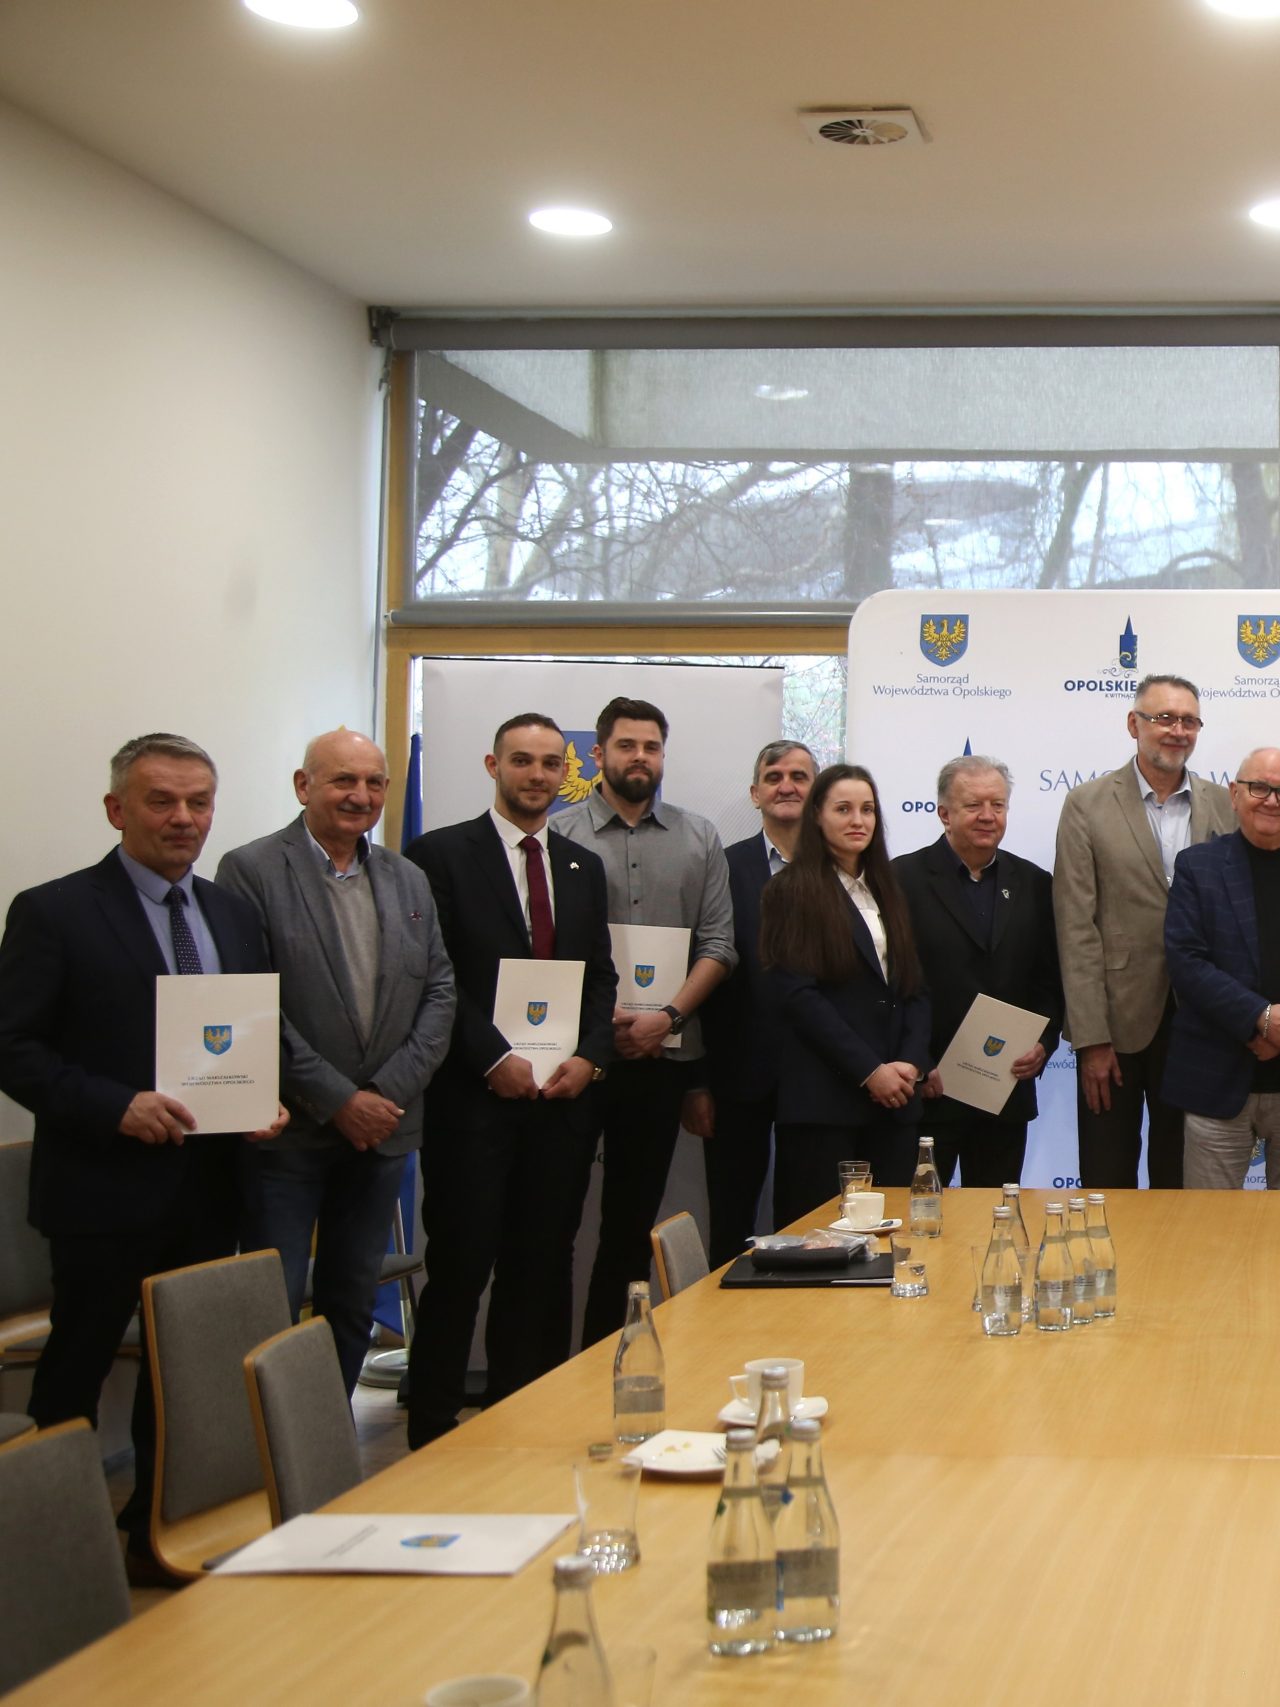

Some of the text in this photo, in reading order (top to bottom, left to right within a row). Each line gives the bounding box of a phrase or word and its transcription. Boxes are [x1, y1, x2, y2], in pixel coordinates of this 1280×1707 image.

[916, 673, 969, 686] Samorząd
[1063, 680, 1137, 691] OPOLSKIE
[873, 684, 1012, 699] Województwa Opolskiego
